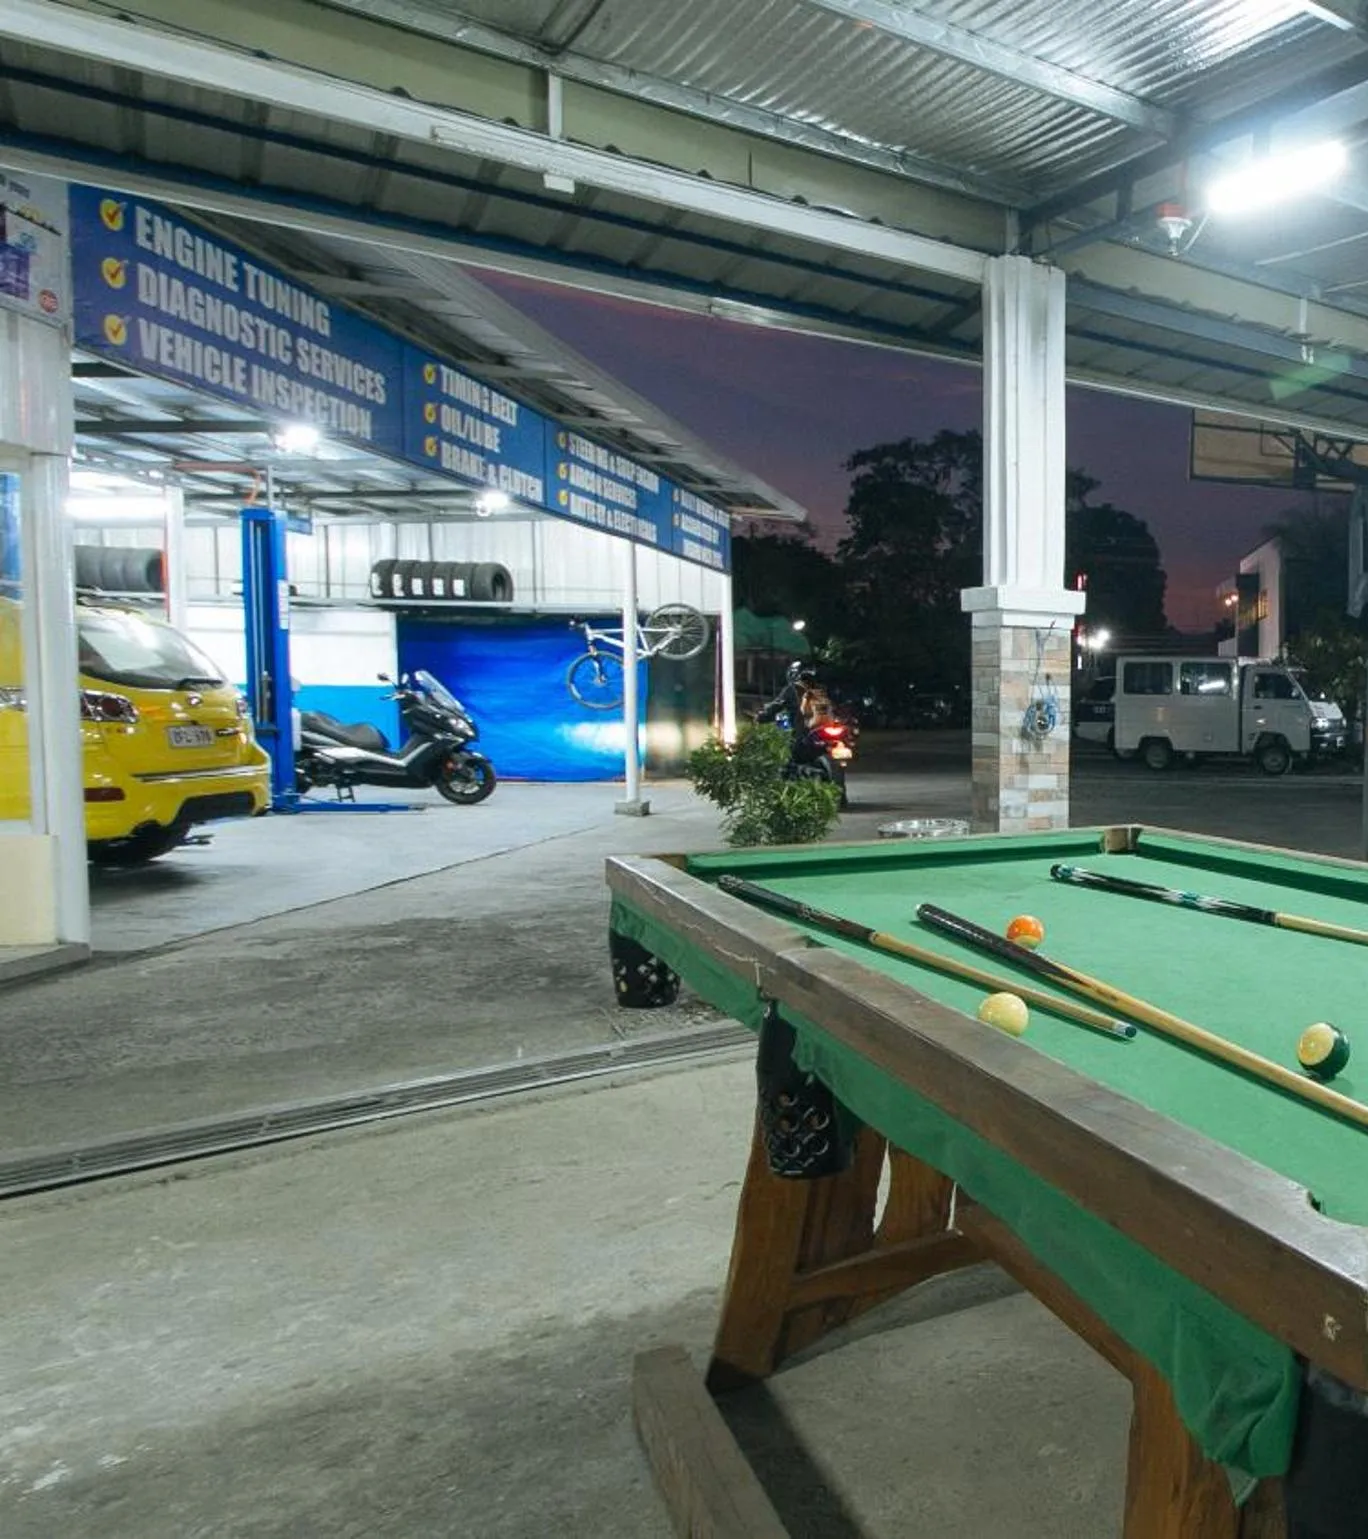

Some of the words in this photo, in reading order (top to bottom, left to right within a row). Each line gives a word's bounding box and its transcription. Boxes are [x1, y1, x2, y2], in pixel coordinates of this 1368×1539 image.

[135, 206, 239, 292] ENGINE
[242, 261, 331, 337] TUNING
[137, 262, 293, 366] DIAGNOSTIC
[295, 337, 386, 405] SERVICES
[138, 317, 247, 394] VEHICLE
[251, 364, 372, 440] INSPECTION
[441, 404, 501, 453] OIL/LUBE
[491, 390, 518, 427] BELT
